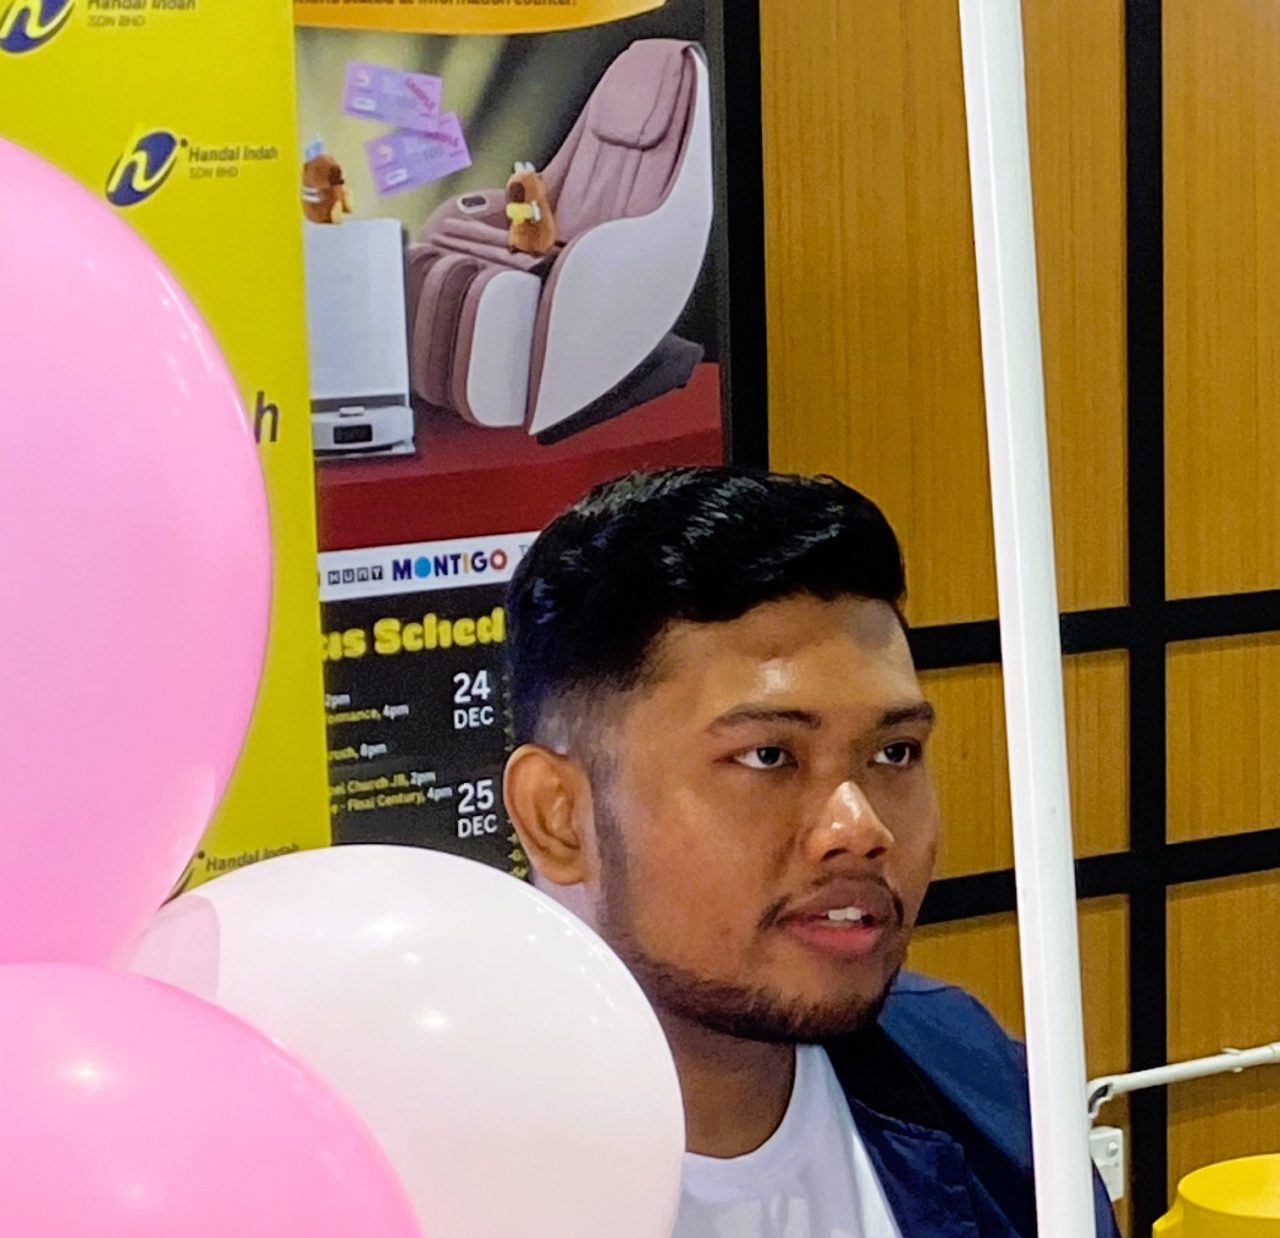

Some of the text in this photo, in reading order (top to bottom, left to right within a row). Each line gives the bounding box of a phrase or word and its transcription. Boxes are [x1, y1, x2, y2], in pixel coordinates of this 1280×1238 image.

[188, 146, 278, 162] Handal Indah
[392, 548, 508, 582] MONTIGO
[373, 606, 506, 655] Sched
[453, 670, 491, 704] 24
[453, 706, 494, 729] DEC
[457, 779, 494, 814] 25
[457, 815, 498, 838] DEC
